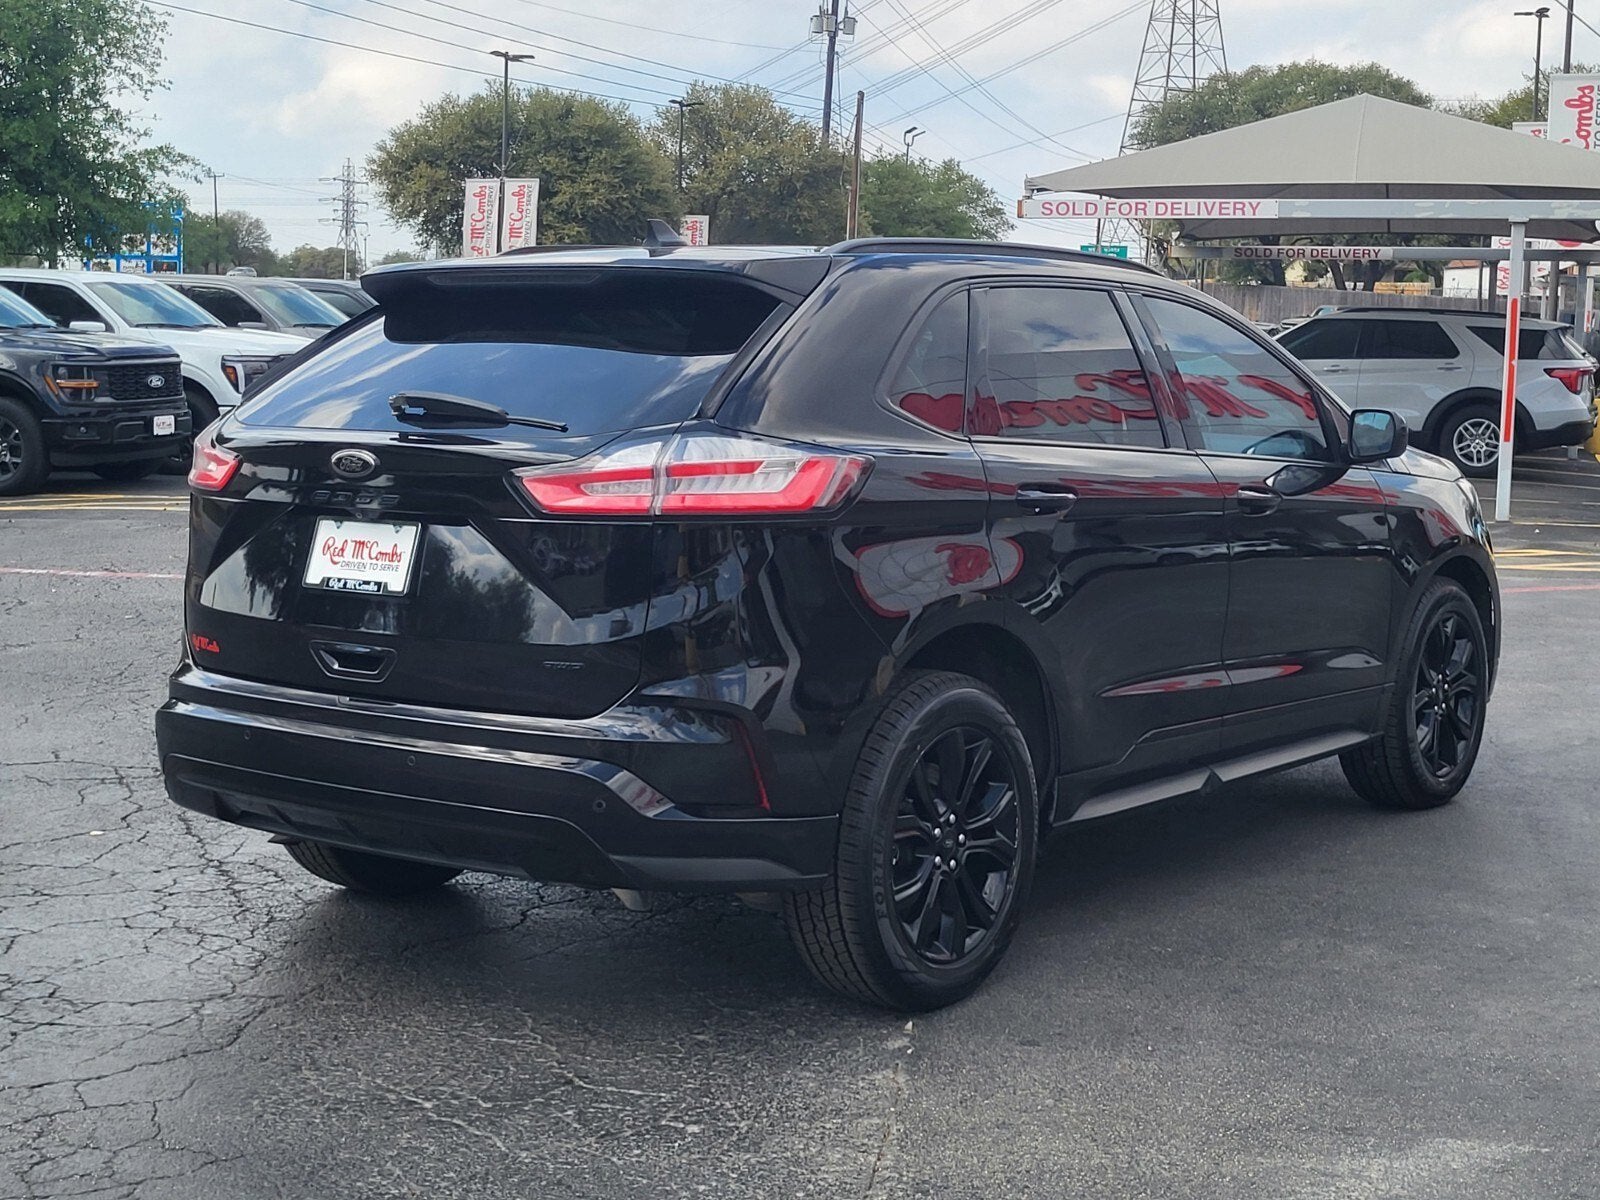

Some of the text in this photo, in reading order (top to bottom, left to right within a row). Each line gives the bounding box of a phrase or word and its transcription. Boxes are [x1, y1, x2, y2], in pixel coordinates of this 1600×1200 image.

[525, 183, 533, 207] SERVE
[470, 185, 488, 243] McCombs
[485, 185, 494, 249] DRIVEN TO SERVE
[508, 184, 527, 243] McCombs
[525, 208, 531, 219] TO
[1041, 201, 1262, 216] SOLD FOR DELIVERY
[1234, 248, 1381, 259] SOLD FOR DELIVERY
[339, 455, 364, 471] Ford
[322, 536, 403, 565] Red McCombs
[340, 560, 401, 572] DRIVEN TO SERVE
